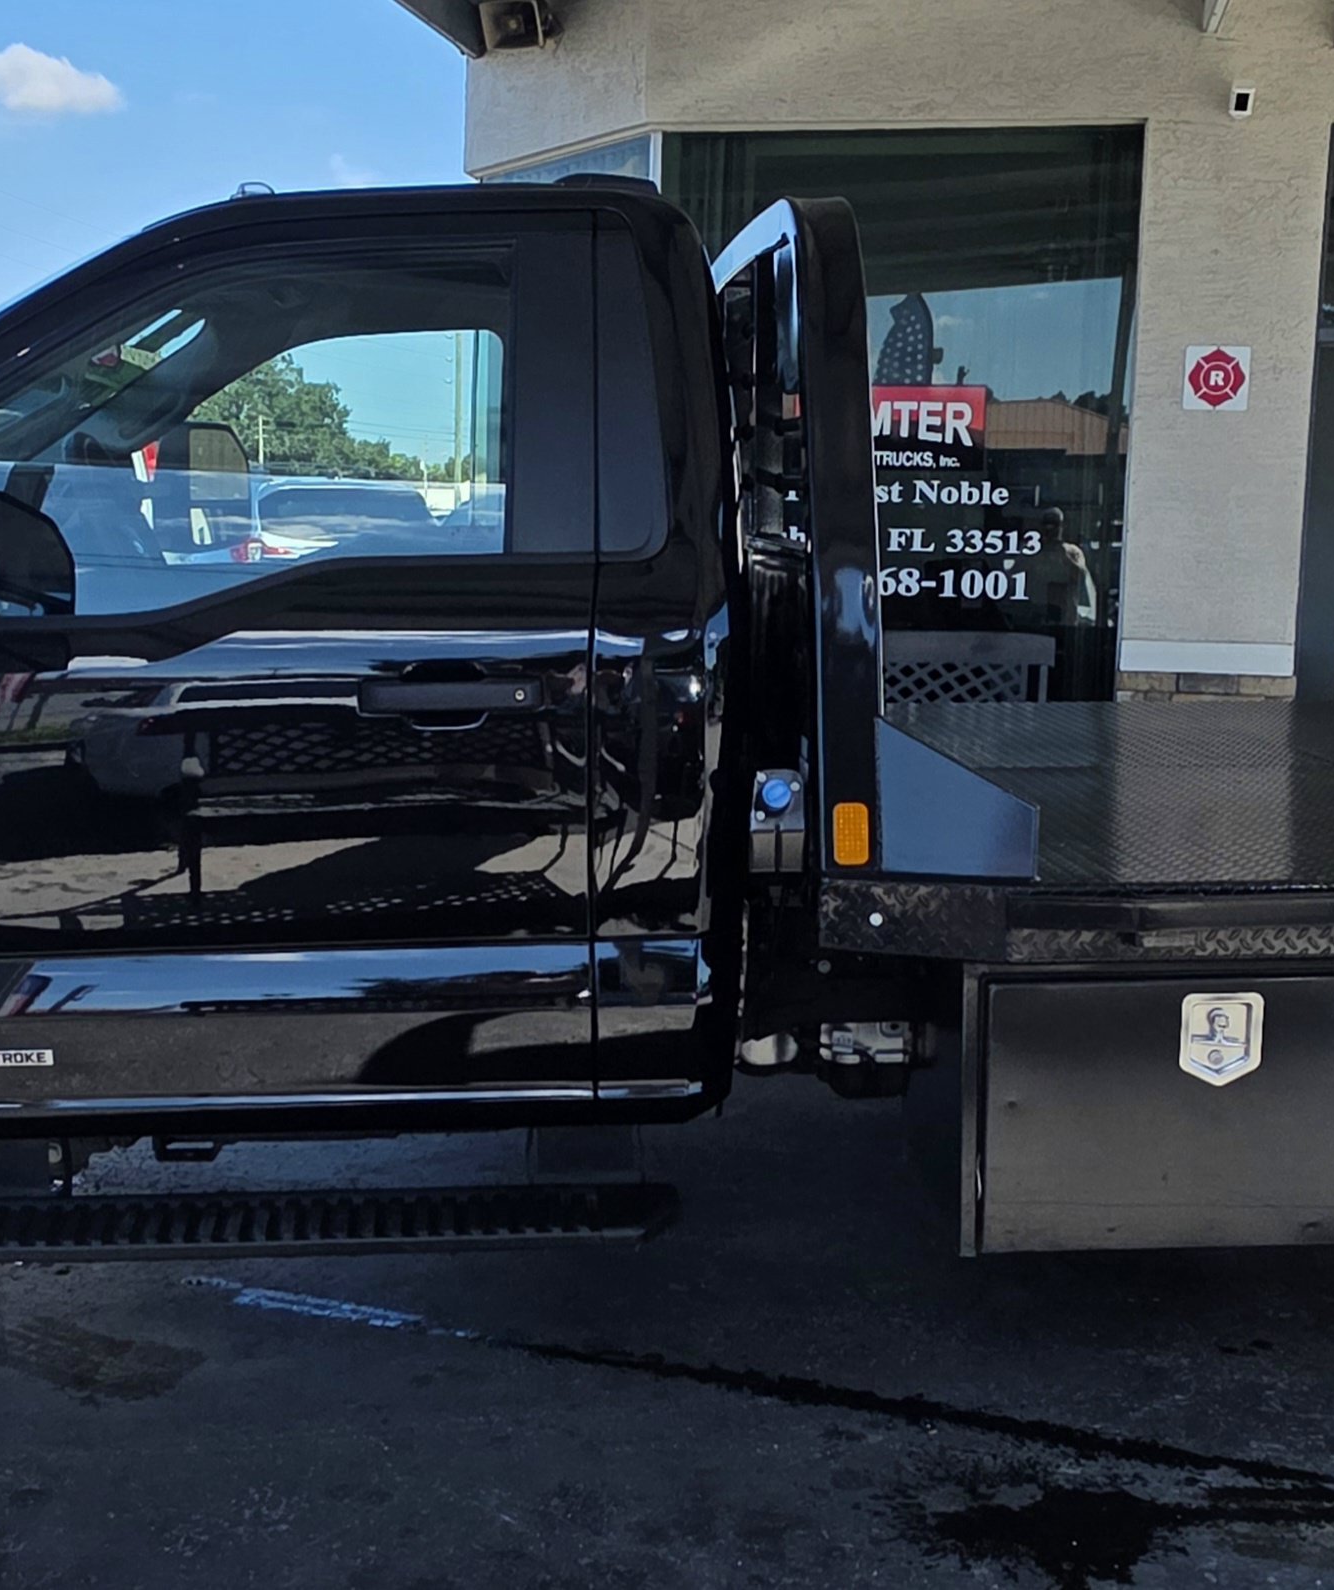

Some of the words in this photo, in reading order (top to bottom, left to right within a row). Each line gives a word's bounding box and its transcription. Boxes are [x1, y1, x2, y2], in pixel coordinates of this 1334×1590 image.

[874, 450, 936, 469] TRUCKS,
[939, 454, 961, 468] Inc.
[912, 480, 1010, 506] Noble
[886, 528, 935, 552] FL
[945, 529, 1042, 555] 33513
